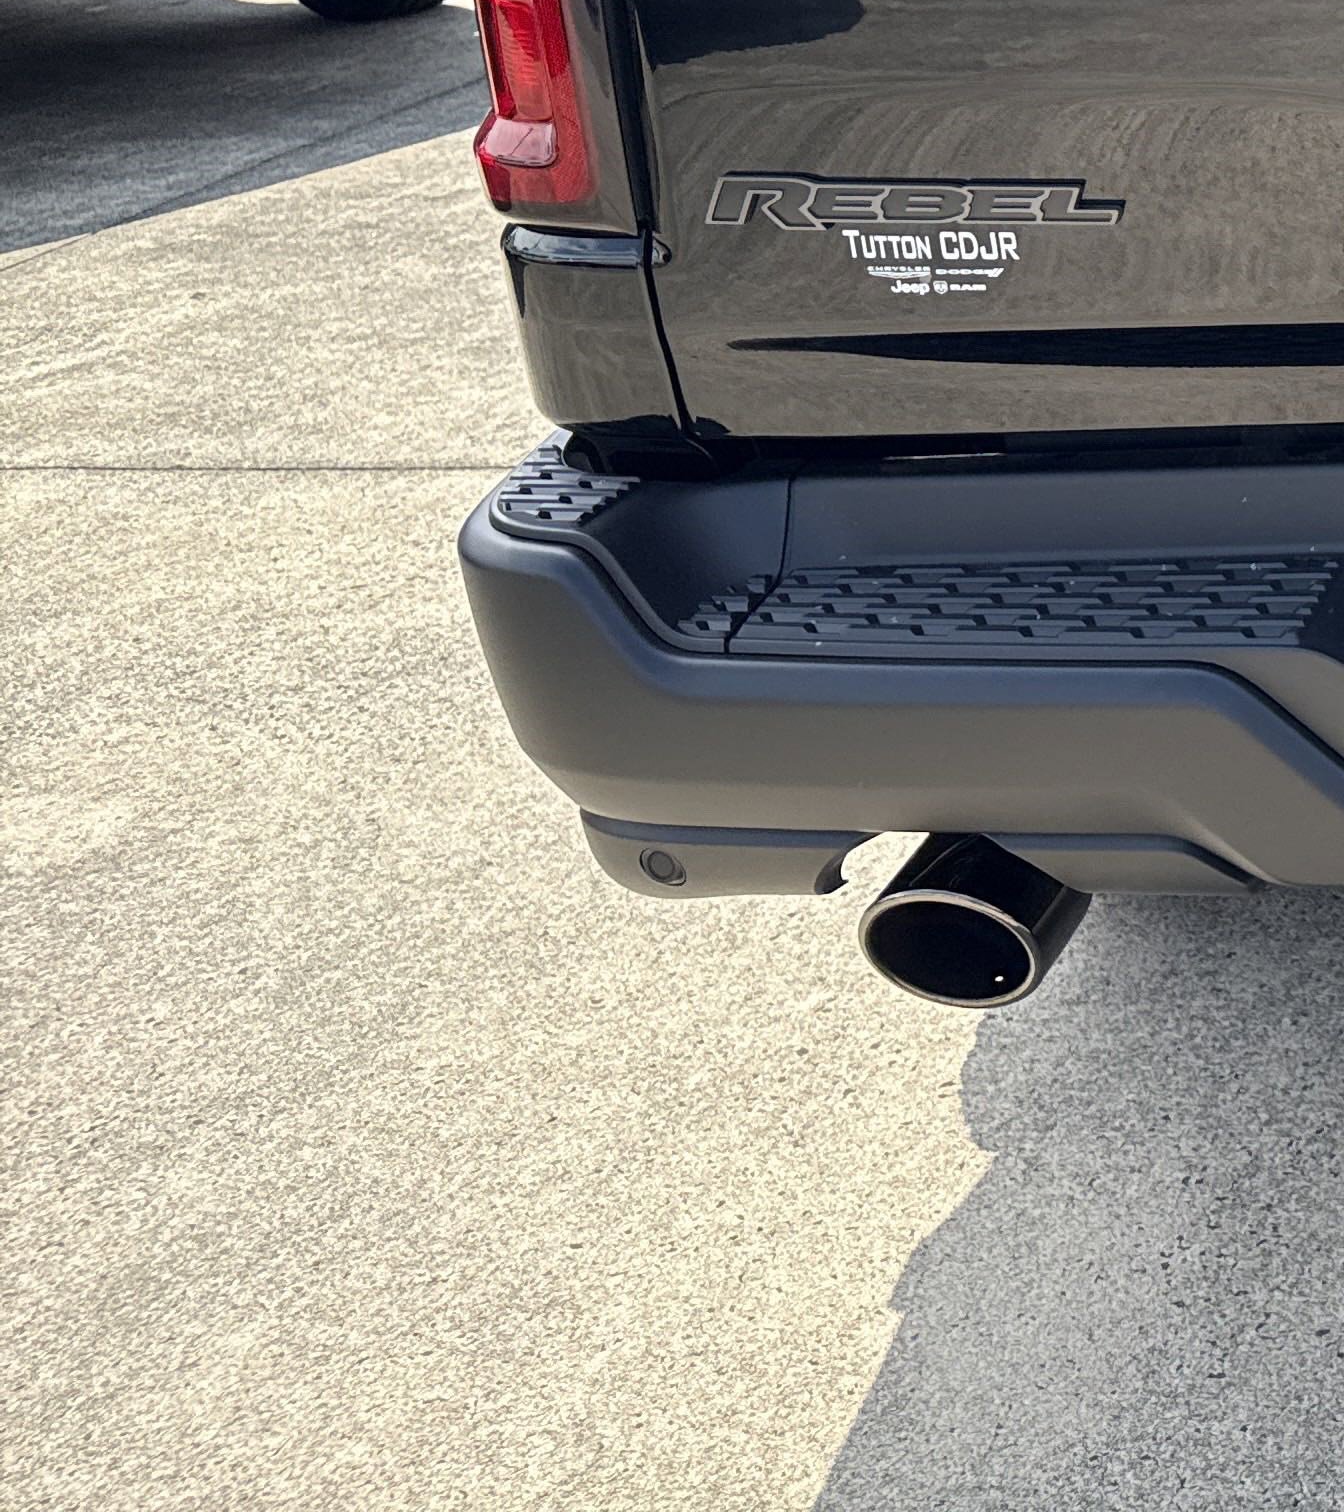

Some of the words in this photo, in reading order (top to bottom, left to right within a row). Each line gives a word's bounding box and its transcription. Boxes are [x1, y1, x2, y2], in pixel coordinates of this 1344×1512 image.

[705, 172, 1126, 231] REBEL
[939, 231, 1021, 261] CDJR
[890, 279, 930, 296] Jeep
